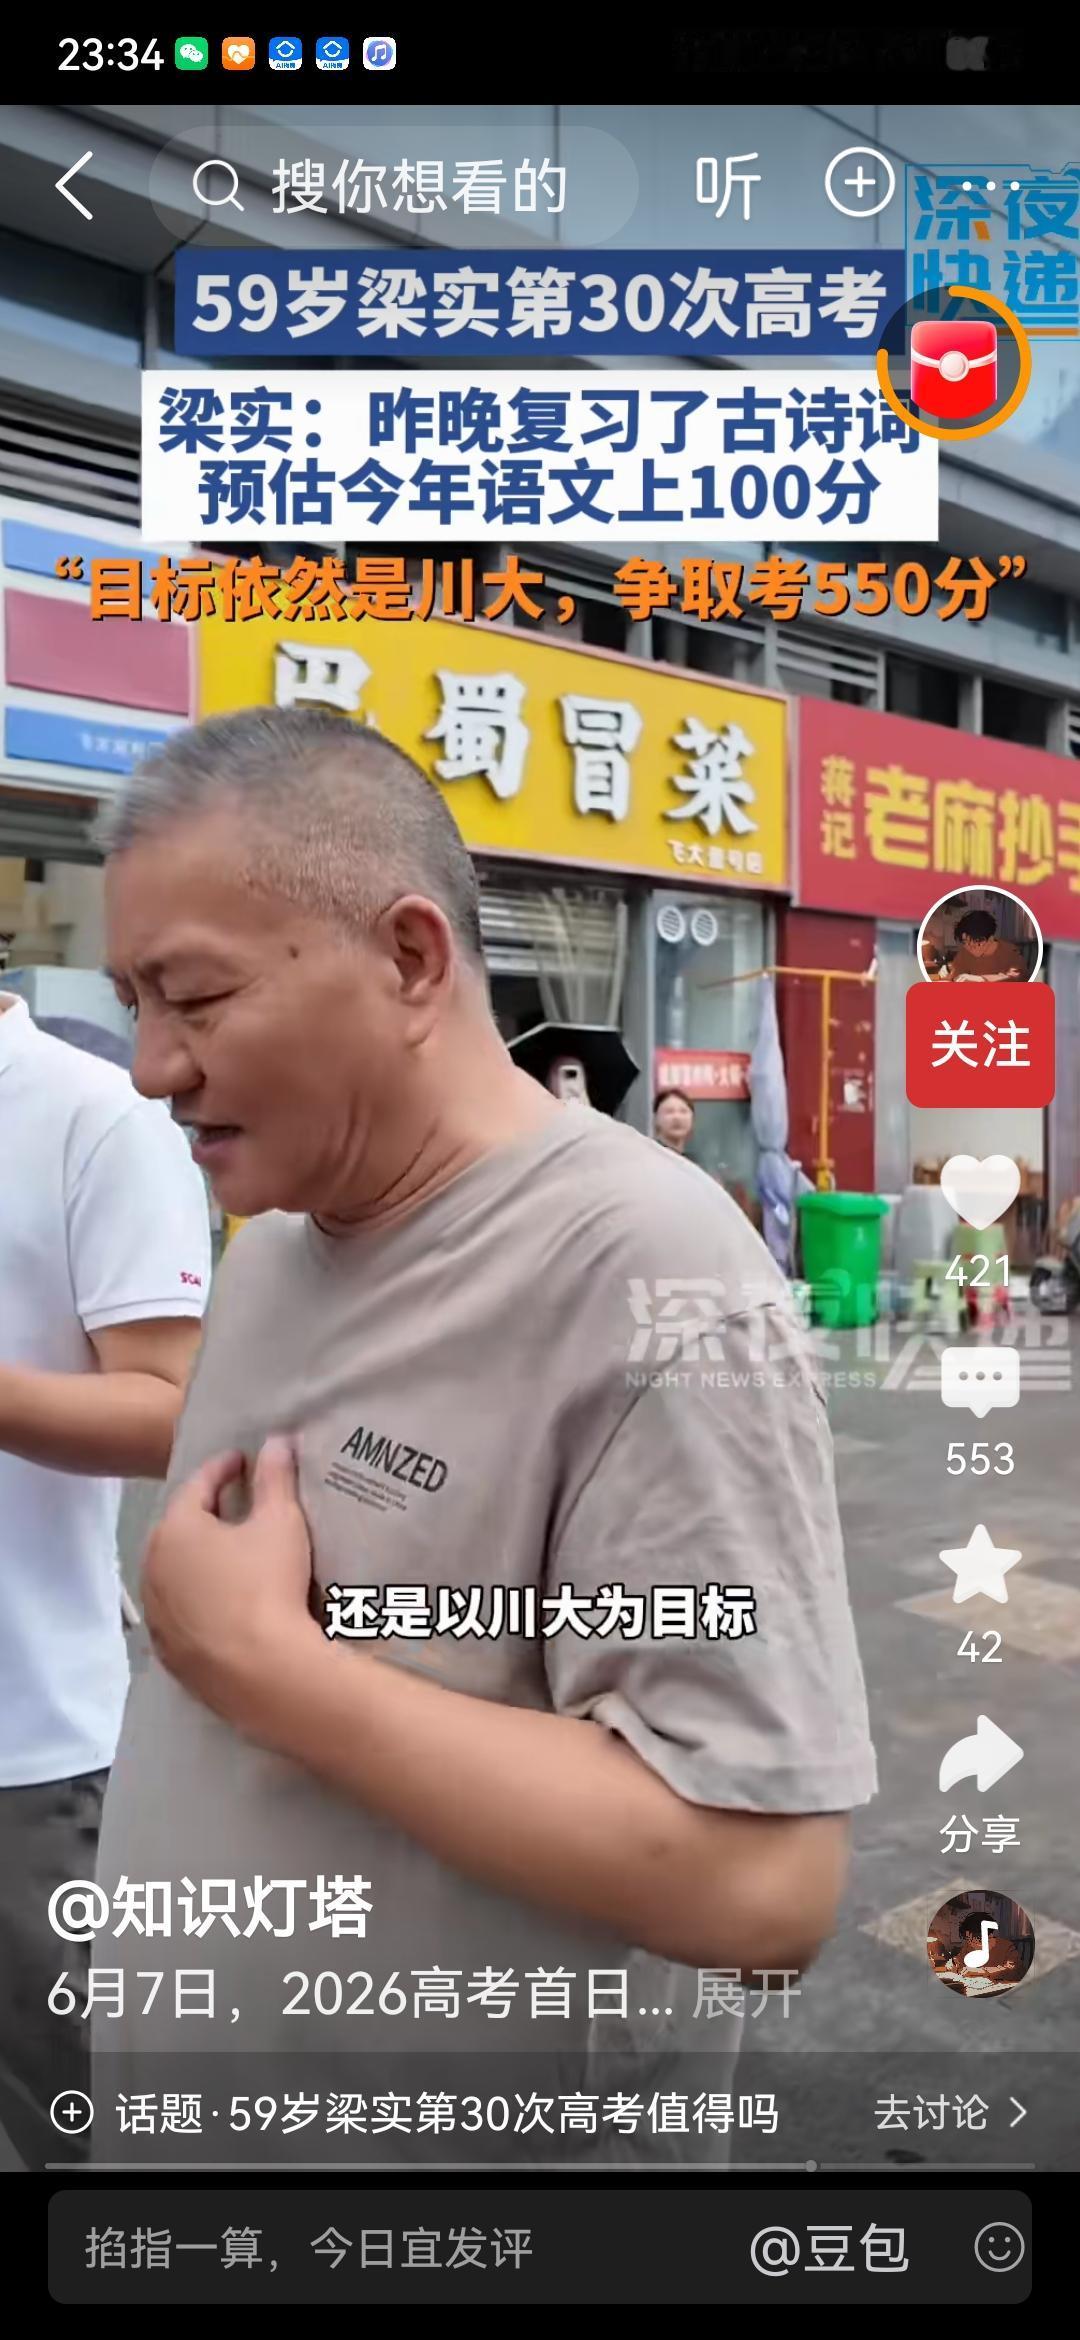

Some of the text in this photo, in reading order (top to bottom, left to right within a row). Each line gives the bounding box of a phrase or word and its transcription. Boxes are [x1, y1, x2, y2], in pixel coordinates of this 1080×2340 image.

[274, 640, 759, 836] 巴蜀冒菜
[340, 1426, 448, 1493] AMNZED
